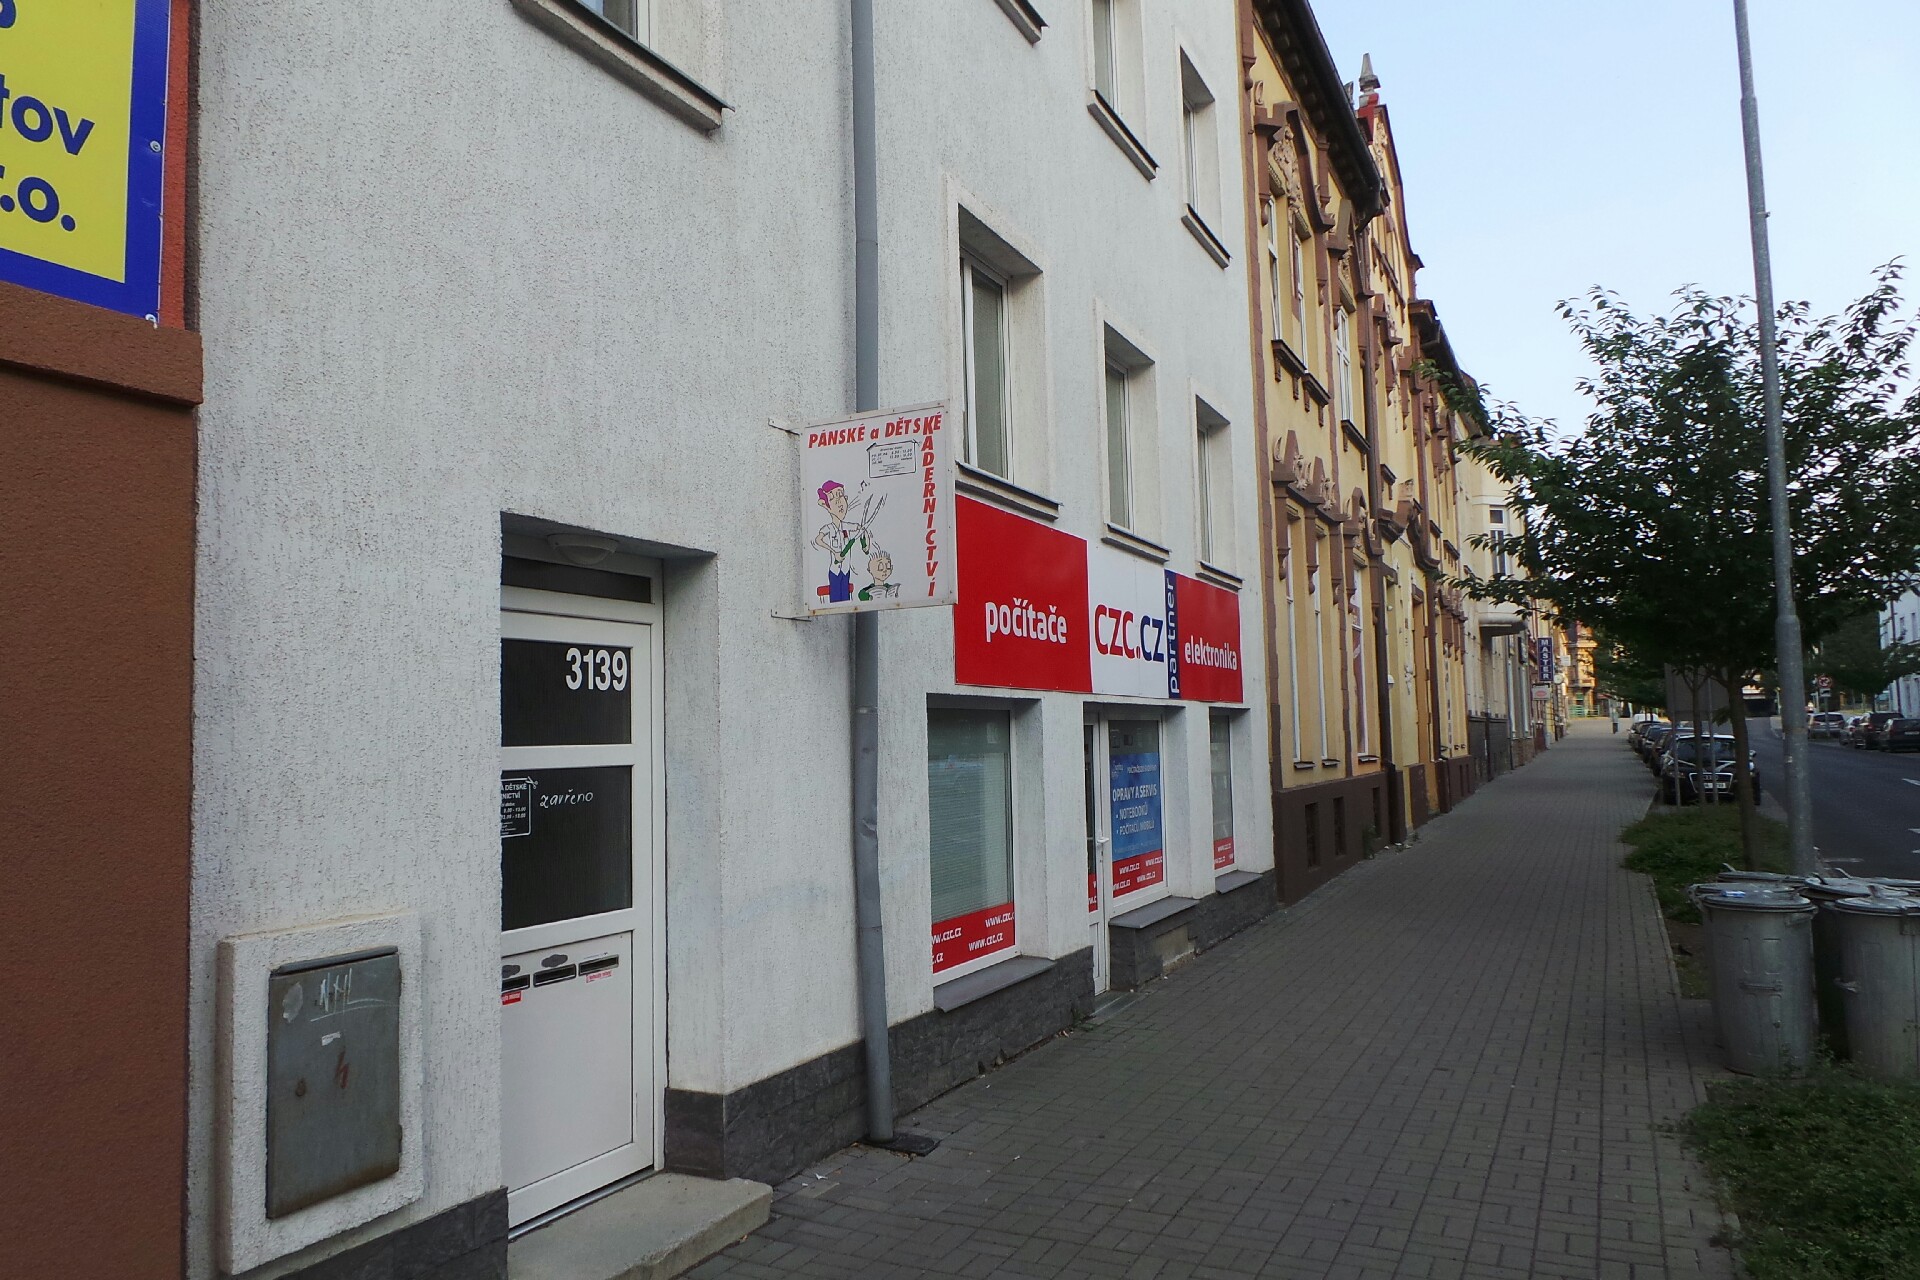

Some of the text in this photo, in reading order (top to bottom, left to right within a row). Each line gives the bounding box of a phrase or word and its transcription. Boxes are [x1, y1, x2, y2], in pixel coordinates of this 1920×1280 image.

[808, 411, 942, 449] PÁNSKÉ a DĚTSKÉ
[985, 597, 1068, 644] počítače
[1094, 603, 1165, 663] CZC.CZ
[1166, 577, 1180, 694] partner
[565, 647, 628, 691] 3139
[1184, 634, 1238, 671] elektronika
[1541, 639, 1549, 680] MASTER
[1112, 786, 1135, 803] OPRAVY
[1135, 785, 1140, 799] A
[968, 932, 1004, 951] www.czc.cz
